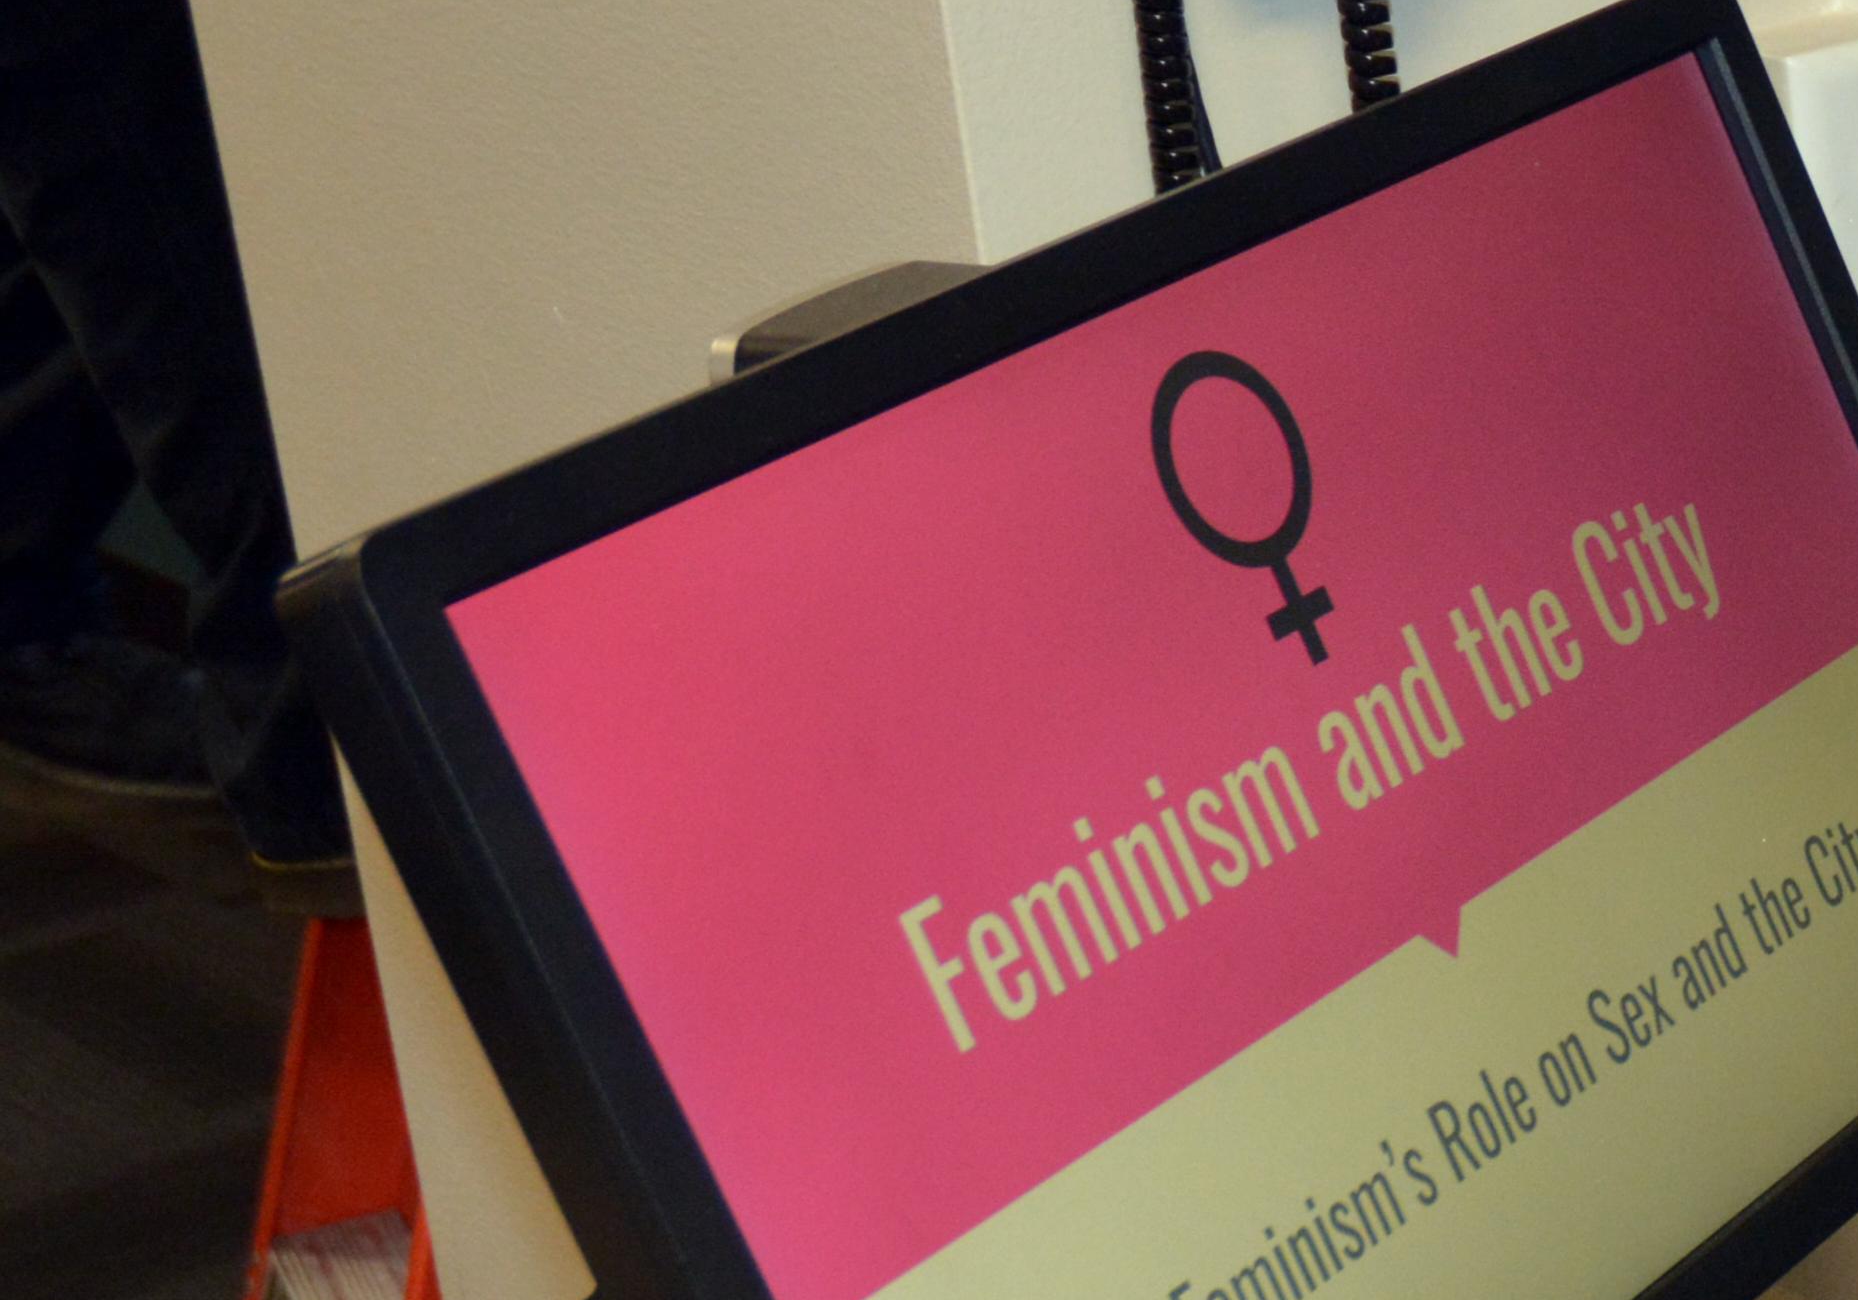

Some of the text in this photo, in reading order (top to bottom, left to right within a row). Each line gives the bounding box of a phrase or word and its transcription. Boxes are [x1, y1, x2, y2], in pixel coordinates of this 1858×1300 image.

[901, 504, 1720, 1050] Feminism and the City
[1426, 1069, 1538, 1183] Role
[1537, 1032, 1597, 1108] on
[1586, 975, 1676, 1065] Sex
[1671, 902, 1749, 1011] and
[1738, 877, 1812, 956] the
